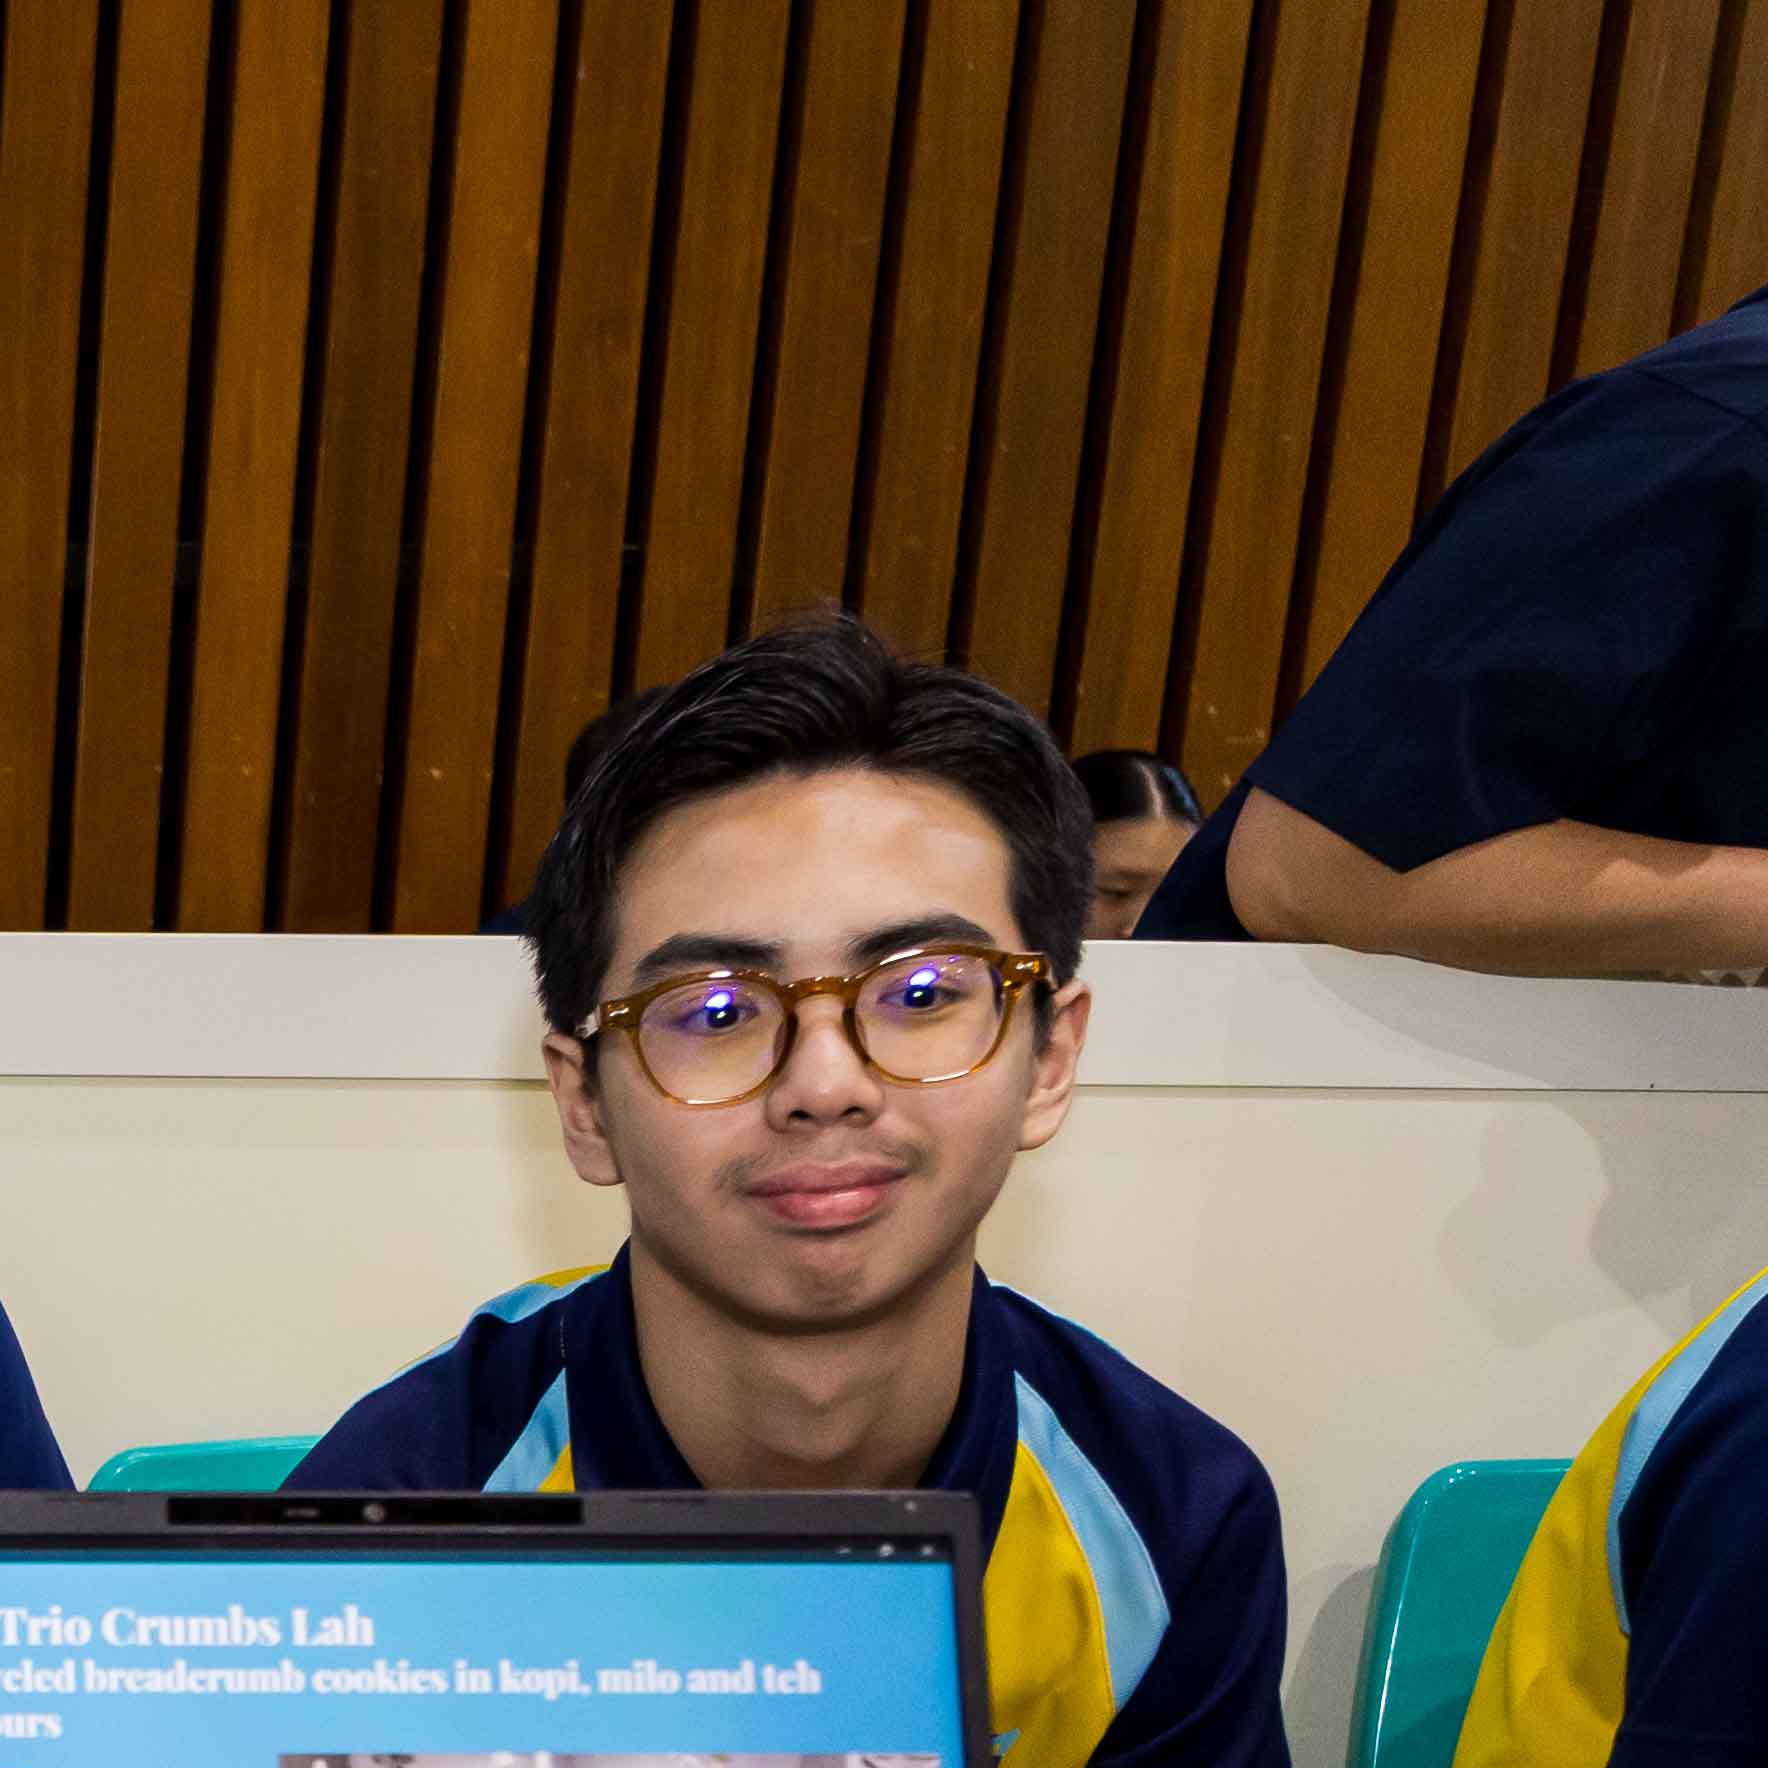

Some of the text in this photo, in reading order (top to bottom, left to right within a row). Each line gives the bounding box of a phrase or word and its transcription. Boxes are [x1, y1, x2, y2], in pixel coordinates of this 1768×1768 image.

[101, 1604, 281, 1646] Crumbs
[291, 1604, 375, 1647] Lah
[83, 1658, 306, 1694] breadcrumb
[311, 1659, 449, 1694] cookies
[455, 1659, 492, 1693] in
[499, 1659, 592, 1701] kopi,
[597, 1659, 681, 1694] milo
[686, 1659, 756, 1694] and
[762, 1659, 822, 1694] teh
